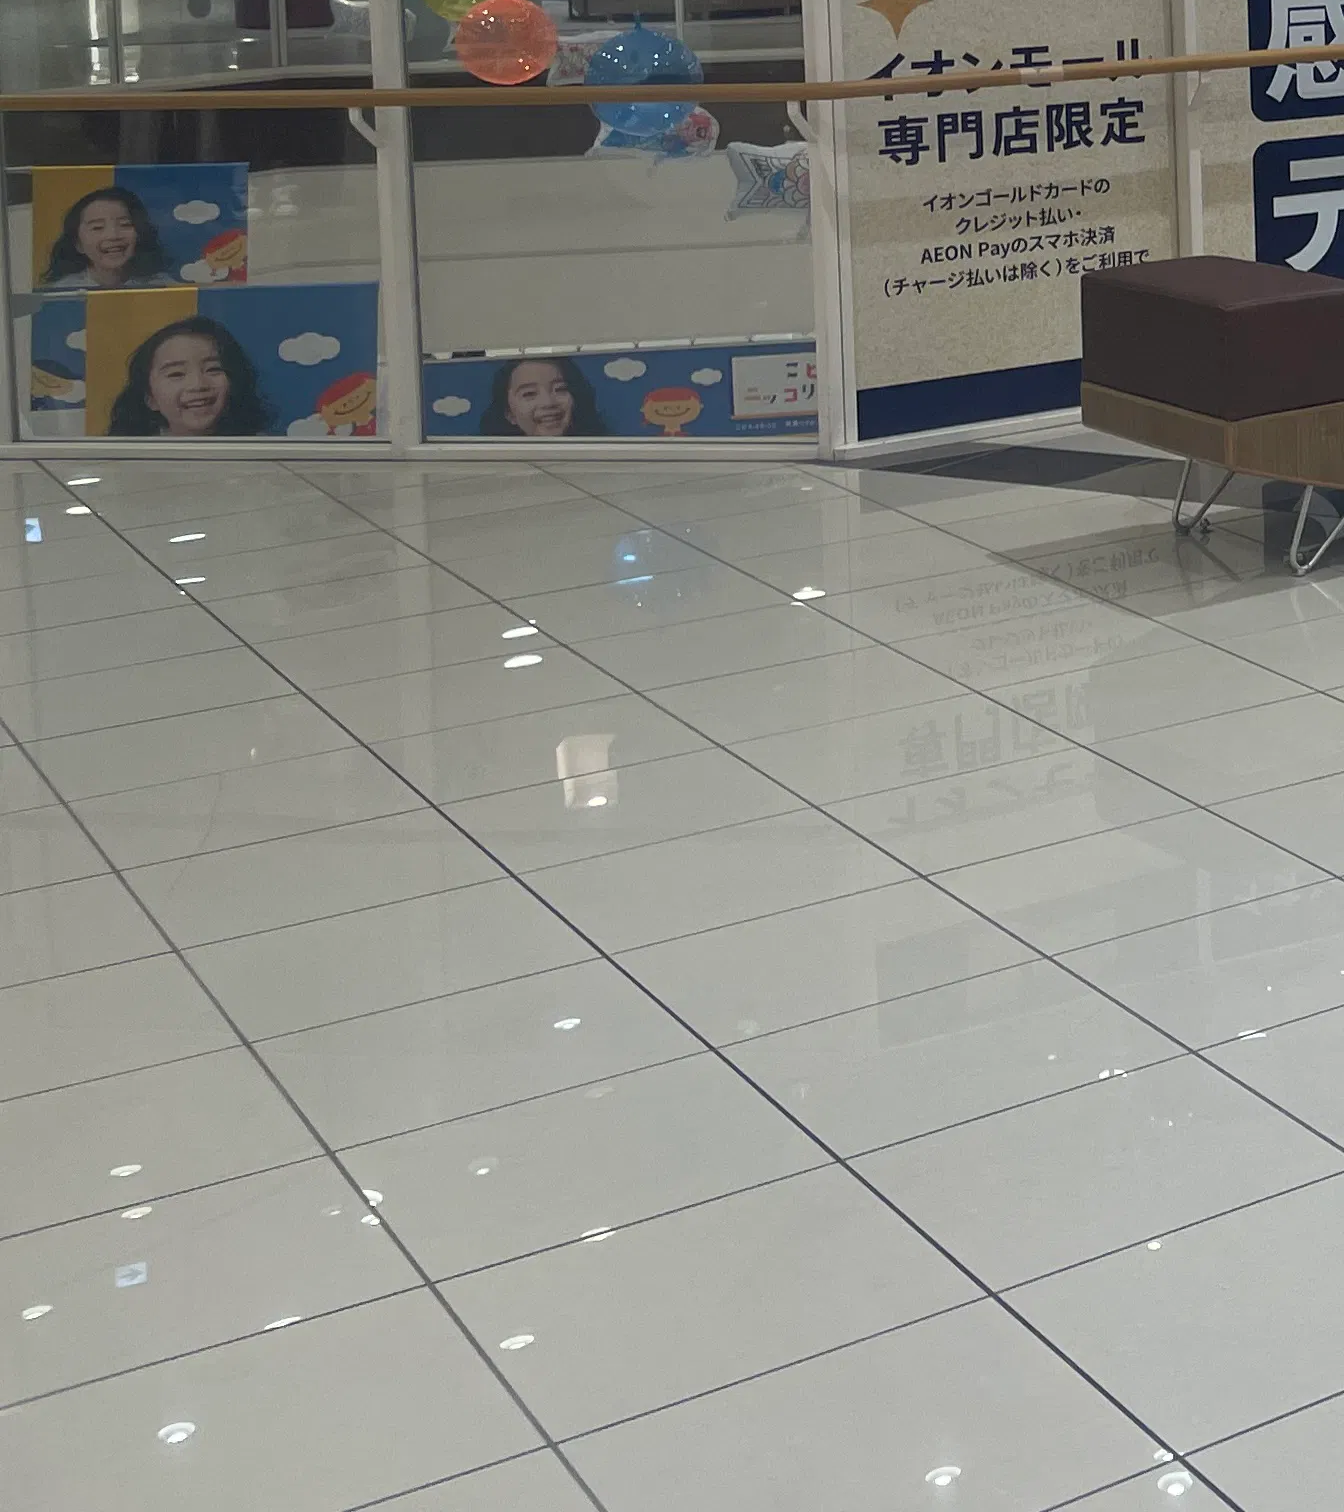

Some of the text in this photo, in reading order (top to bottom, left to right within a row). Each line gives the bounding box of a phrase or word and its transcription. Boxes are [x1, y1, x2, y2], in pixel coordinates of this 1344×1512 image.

[877, 96, 1146, 166] 専門店限定
[922, 178, 1110, 213] イオンゴールドカードの
[920, 243, 973, 265] AEON
